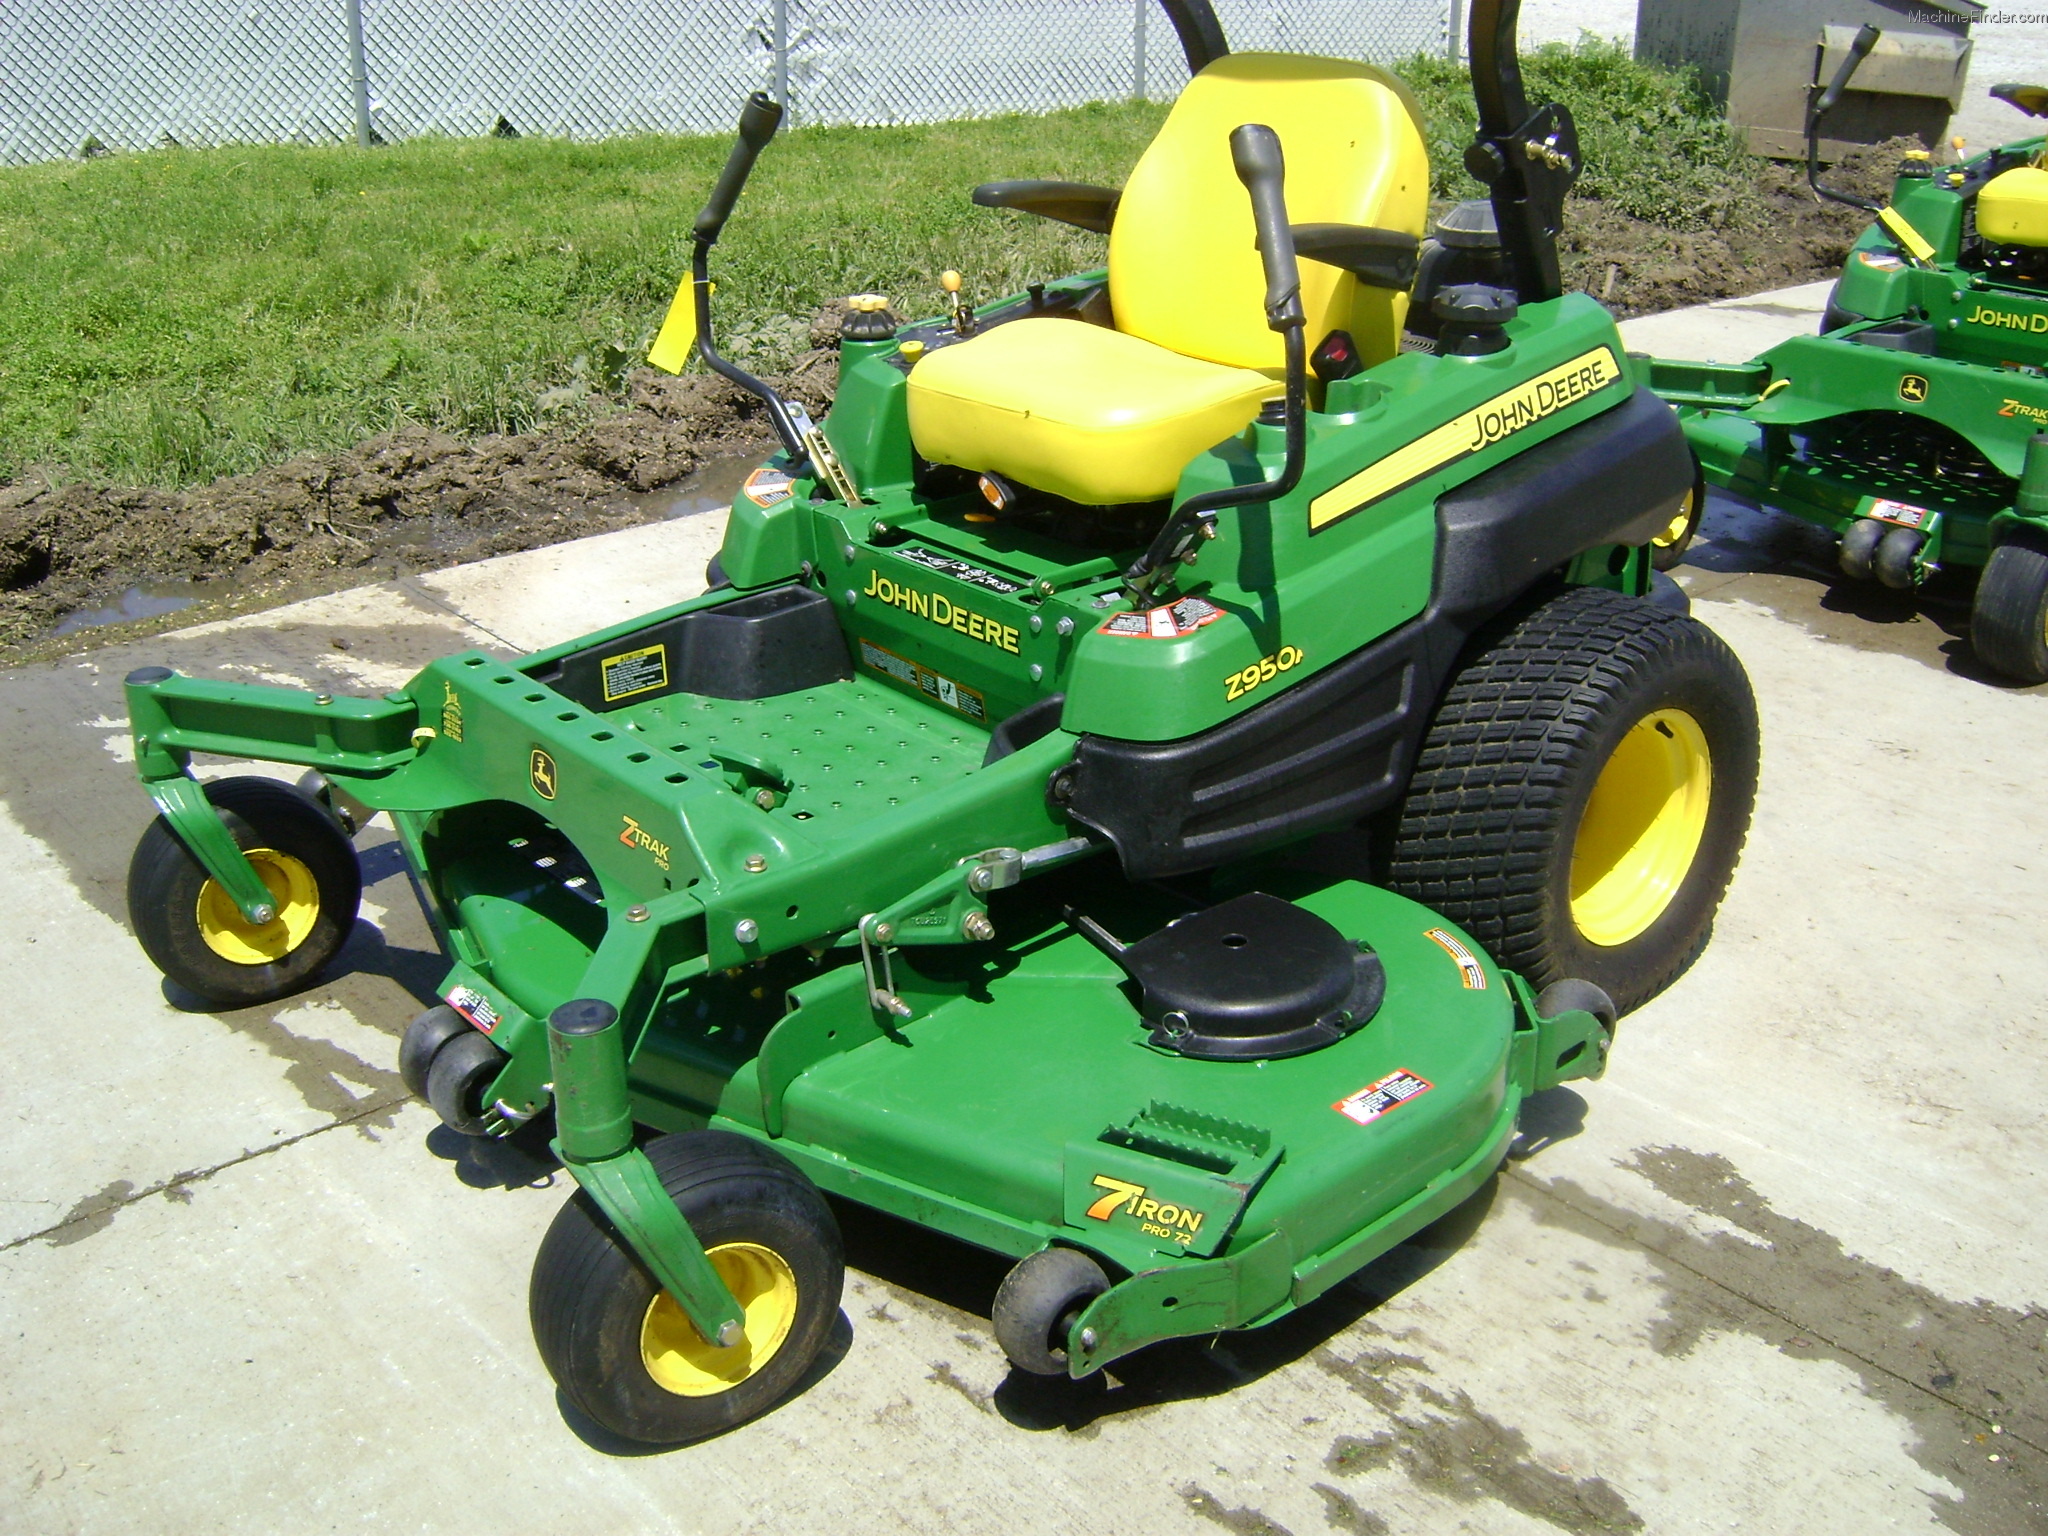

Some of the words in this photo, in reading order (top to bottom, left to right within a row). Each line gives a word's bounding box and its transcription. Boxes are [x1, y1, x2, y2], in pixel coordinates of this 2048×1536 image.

[1967, 305, 2028, 331] JOHN
[1471, 396, 1534, 448] JOHN
[1536, 360, 1606, 412] DEERE
[864, 569, 929, 619] JOHN
[932, 592, 1020, 655] DEERE
[654, 857, 669, 871] PRO
[1141, 1222, 1171, 1238] PRO
[1174, 1231, 1193, 1246] 72
